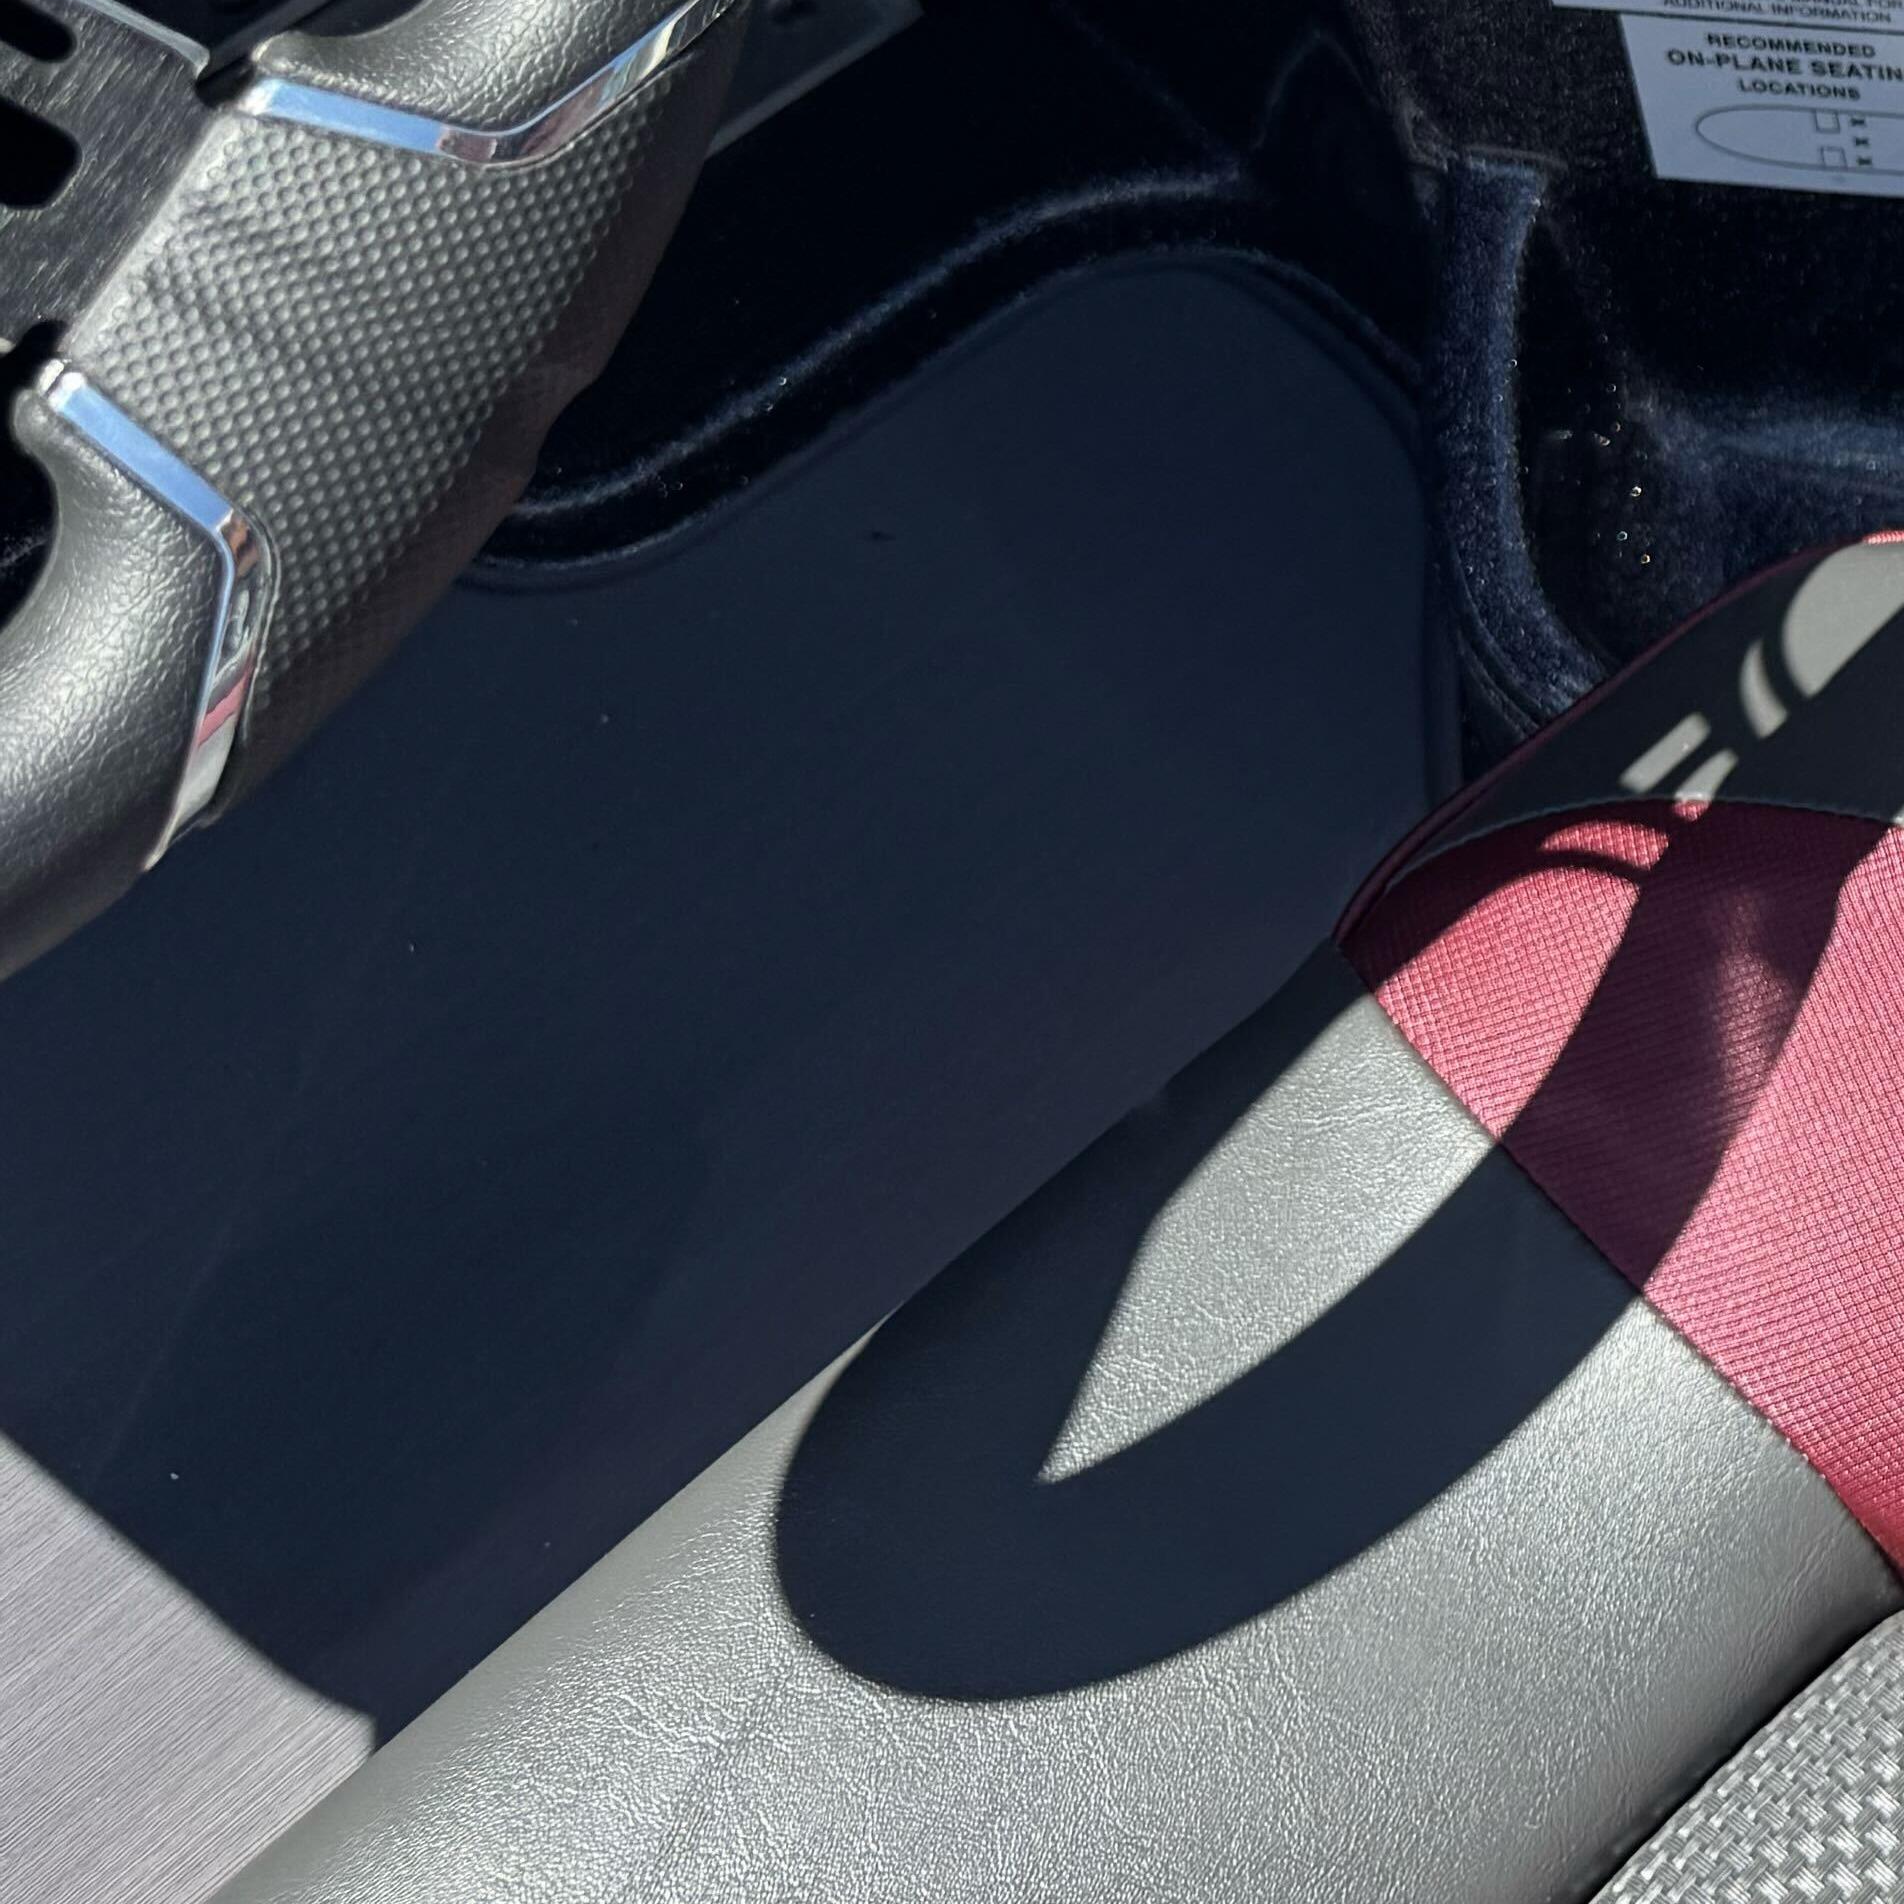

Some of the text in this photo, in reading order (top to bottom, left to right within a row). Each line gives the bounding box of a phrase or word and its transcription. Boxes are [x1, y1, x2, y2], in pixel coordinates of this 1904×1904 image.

[1704, 32, 1876, 58] RECOMMENDED
[1665, 48, 1803, 75] ON-PLANE
[1737, 77, 1861, 100] LOCATIONS
